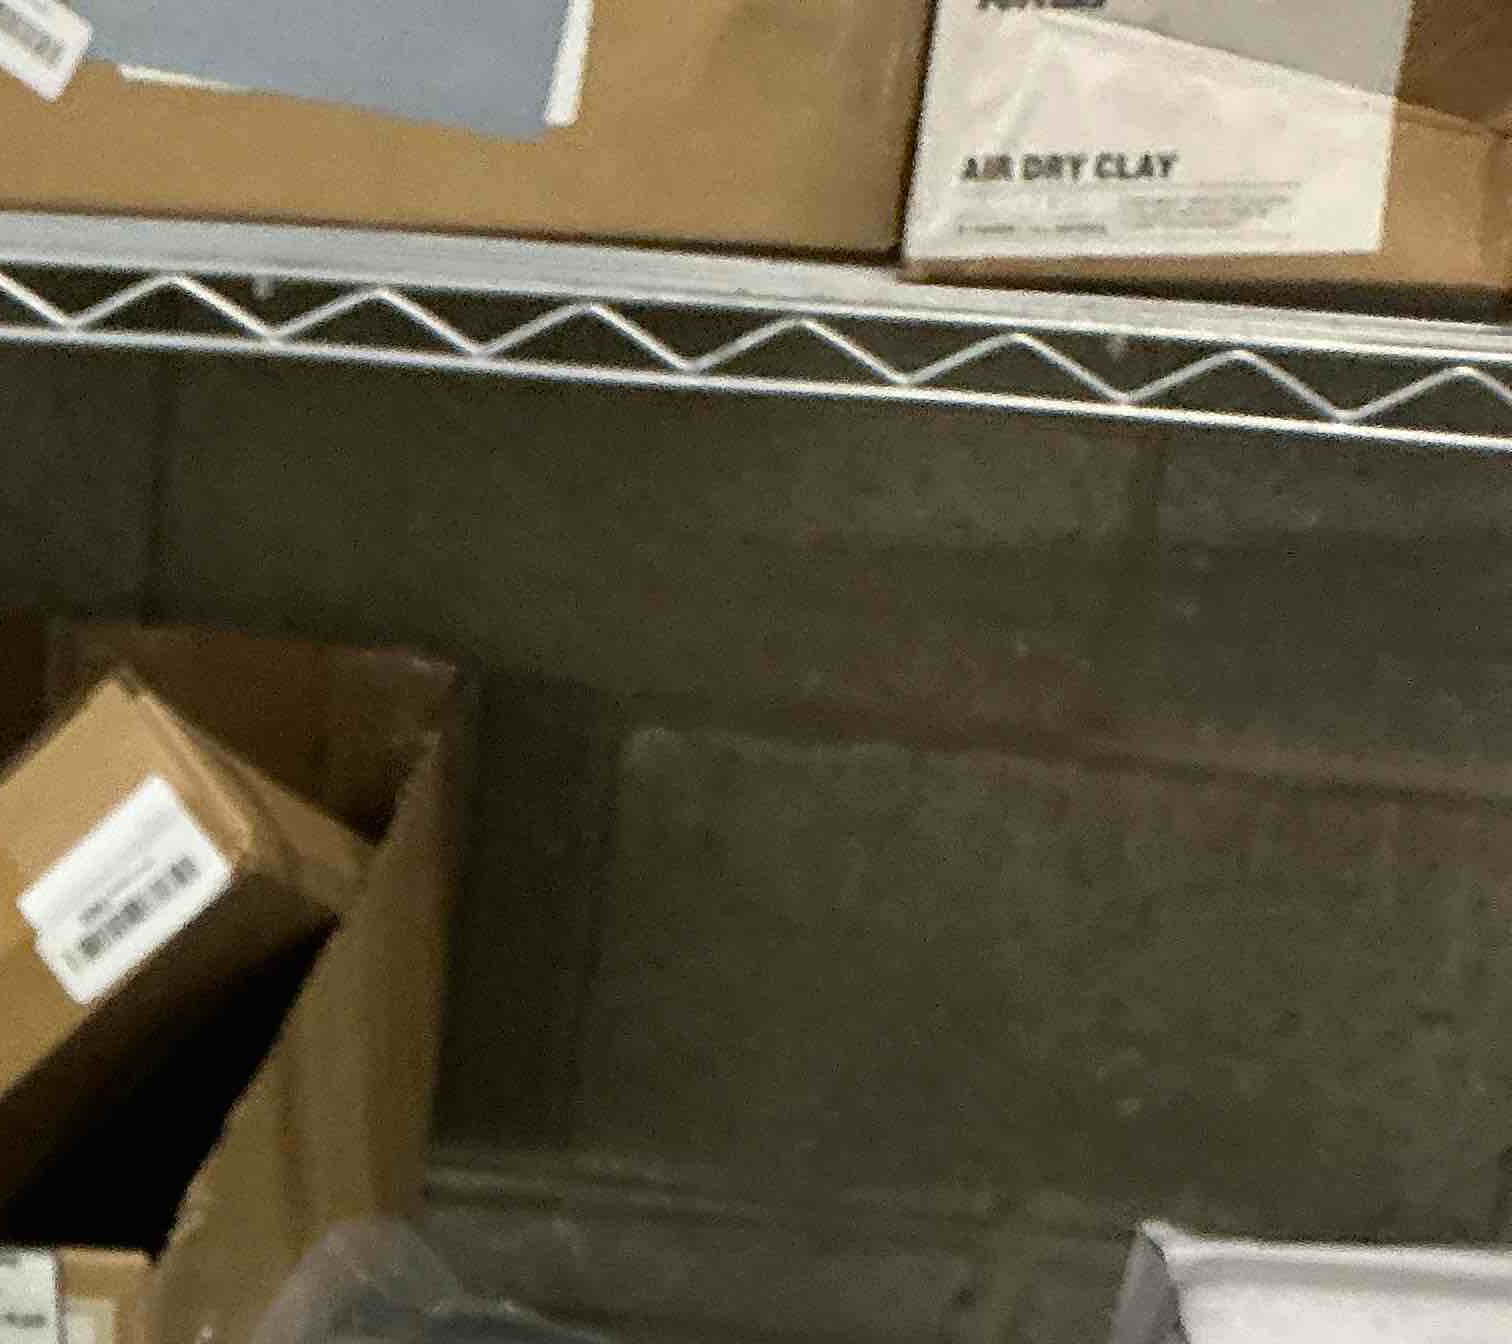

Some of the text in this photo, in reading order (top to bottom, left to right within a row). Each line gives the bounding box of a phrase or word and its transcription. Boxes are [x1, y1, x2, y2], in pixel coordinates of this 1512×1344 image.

[962, 151, 1180, 181] AIR DRY CLAY
